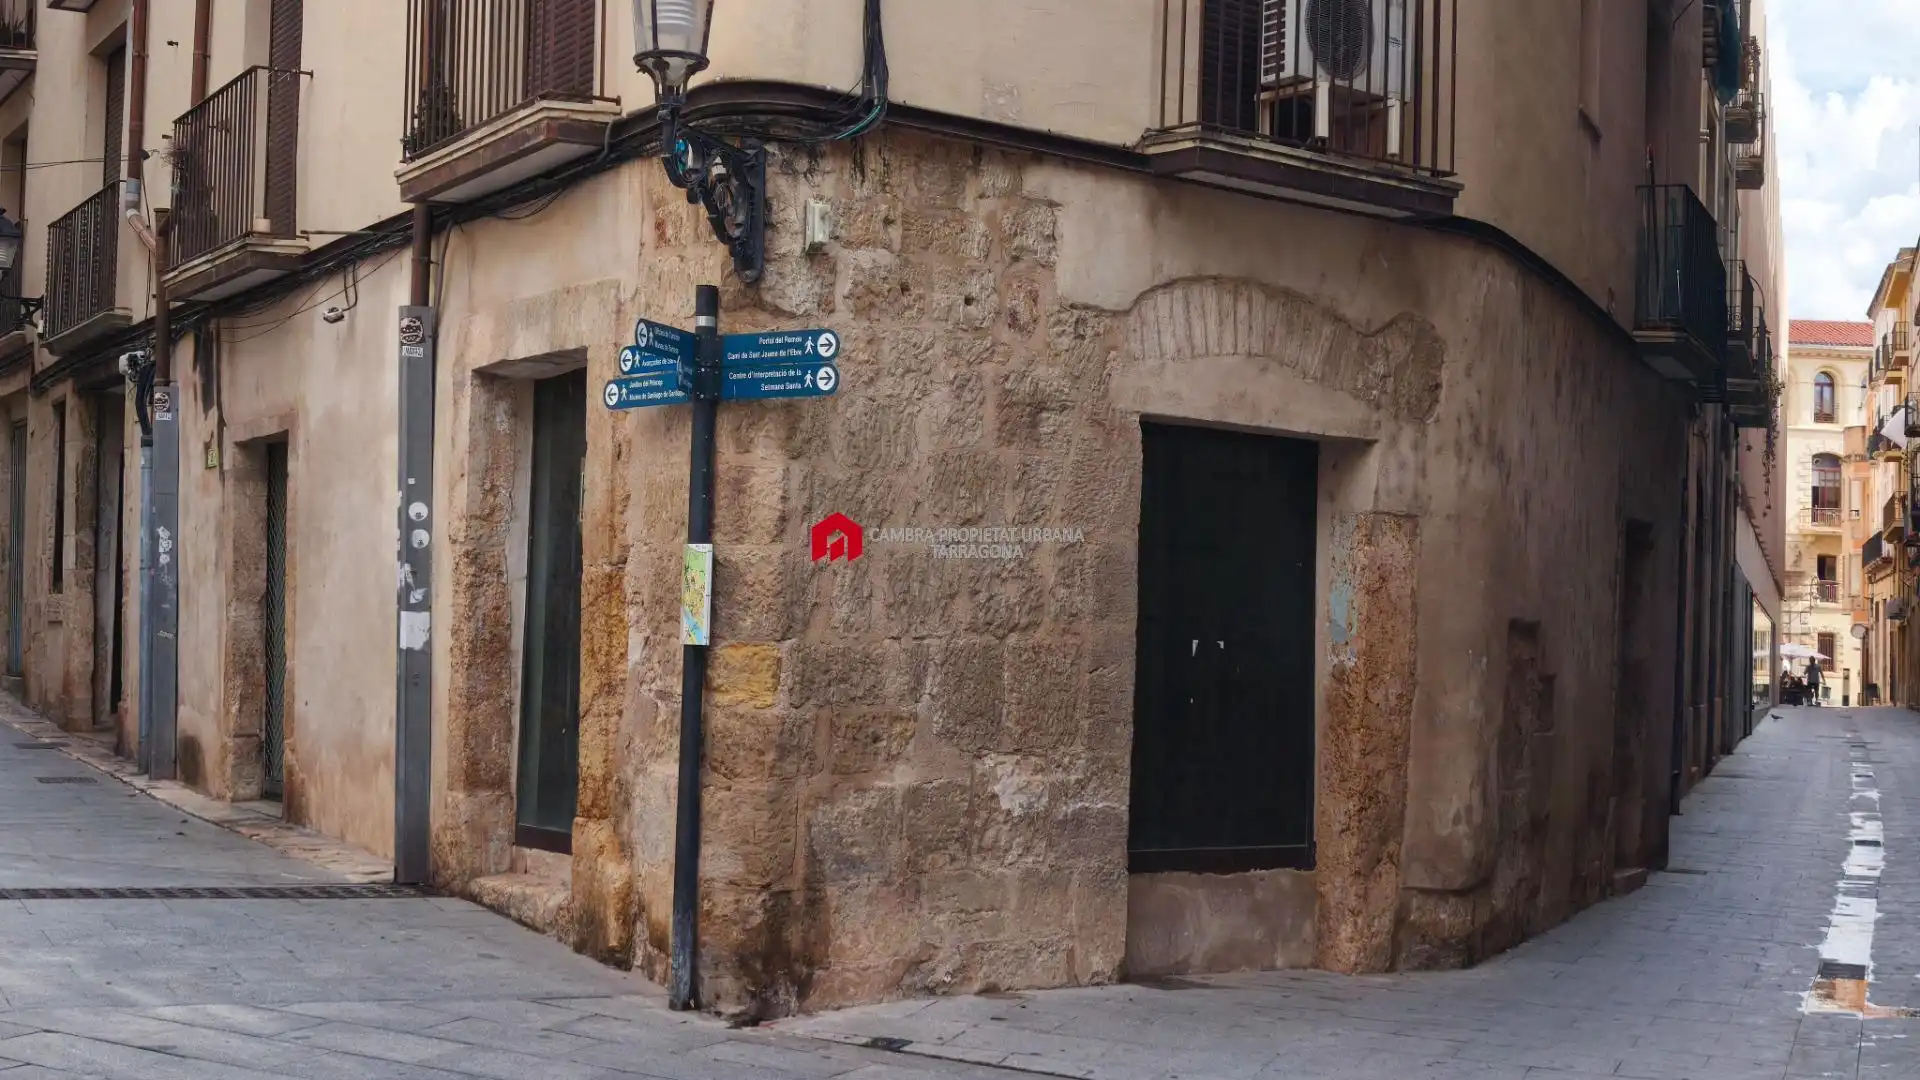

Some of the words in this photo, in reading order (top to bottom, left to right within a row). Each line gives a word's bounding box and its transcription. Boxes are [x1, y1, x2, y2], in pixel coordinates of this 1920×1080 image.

[775, 336, 783, 344] del
[741, 351, 748, 359] de
[728, 372, 746, 380] Centre
[796, 368, 802, 376] la
[785, 381, 802, 390] Santa
